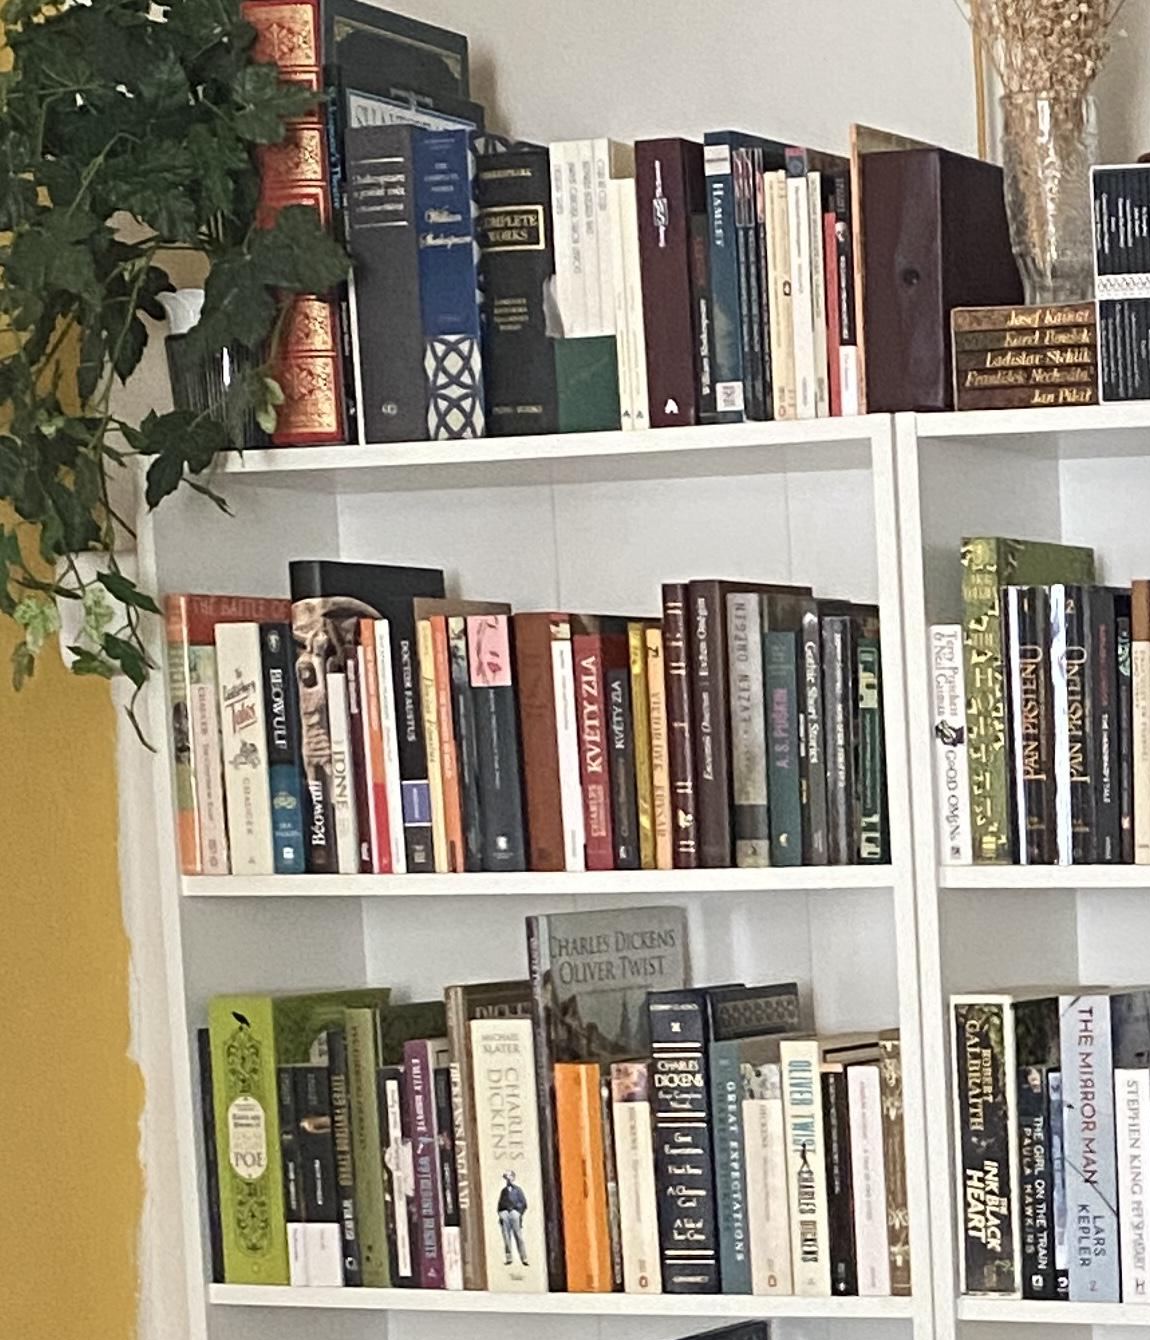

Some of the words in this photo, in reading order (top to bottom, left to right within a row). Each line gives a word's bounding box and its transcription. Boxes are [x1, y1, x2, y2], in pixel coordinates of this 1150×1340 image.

[712, 183, 724, 248] HAMLET
[401, 640, 413, 688] DOCTOR
[805, 641, 818, 683] Gothic
[270, 669, 287, 749] BEOWULF
[404, 690, 416, 741] FAUSTUS
[806, 686, 819, 720] Short
[808, 722, 820, 763] Stories
[614, 929, 676, 950] DICKENS
[558, 960, 616, 984] OLIVER
[619, 955, 667, 977] TWIST
[1078, 1007, 1094, 1046] THE
[654, 1073, 704, 1087] DICKENS
[965, 1020, 984, 1131] GALBRAITH
[981, 1049, 994, 1103] ROBERT
[488, 1068, 506, 1161] DICKENS
[505, 1067, 522, 1160] CHARLES
[725, 1081, 739, 1131] GREAT
[1033, 1116, 1043, 1140] THE
[233, 1151, 264, 1168] POE
[1023, 1128, 1033, 1175] PAULA
[1034, 1146, 1045, 1175] GIRL
[1082, 1137, 1098, 1185] MAN
[983, 1160, 999, 1191] INK
[1035, 1180, 1046, 1200] ON
[729, 1141, 744, 1261] EXPECTATIONS
[966, 1169, 986, 1243] HEART
[986, 1195, 1001, 1252] BLACK
[1025, 1184, 1034, 1254] HAWKINS
[1036, 1204, 1046, 1228] THE
[1037, 1231, 1047, 1269] TRAIN
[1077, 1204, 1091, 1267] KEPLER
[1093, 1215, 1106, 1257] LARS
